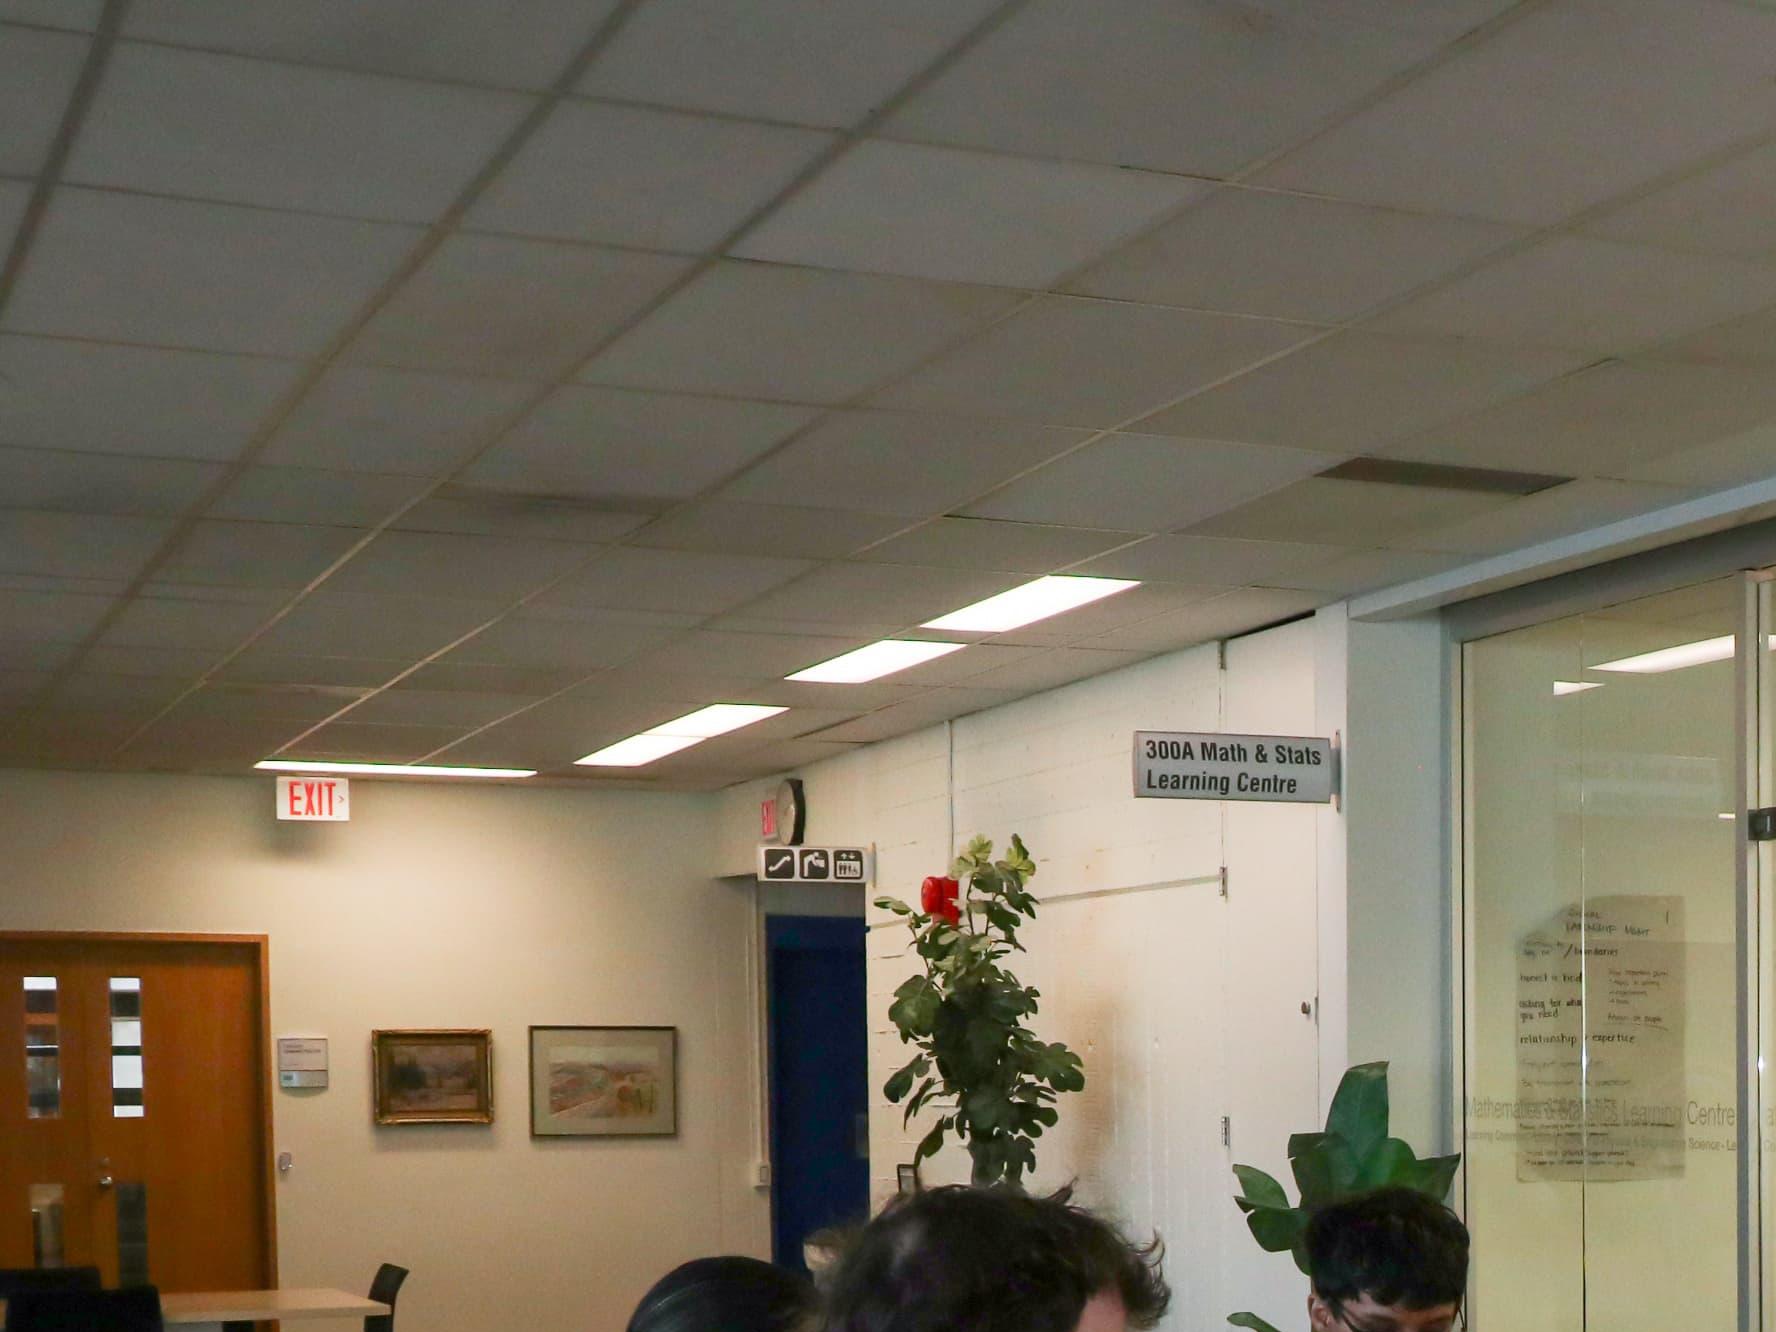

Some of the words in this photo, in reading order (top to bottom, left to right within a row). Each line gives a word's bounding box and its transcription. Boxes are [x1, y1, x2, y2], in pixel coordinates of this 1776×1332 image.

[1146, 740, 1194, 761] 300A
[1201, 742, 1247, 763] Math
[1255, 744, 1268, 764] &
[1275, 745, 1321, 766] Stats
[1146, 769, 1230, 796] Learning
[1237, 772, 1297, 794] Centre
[288, 780, 336, 816] EXIT
[1686, 1100, 1736, 1127] Centre
